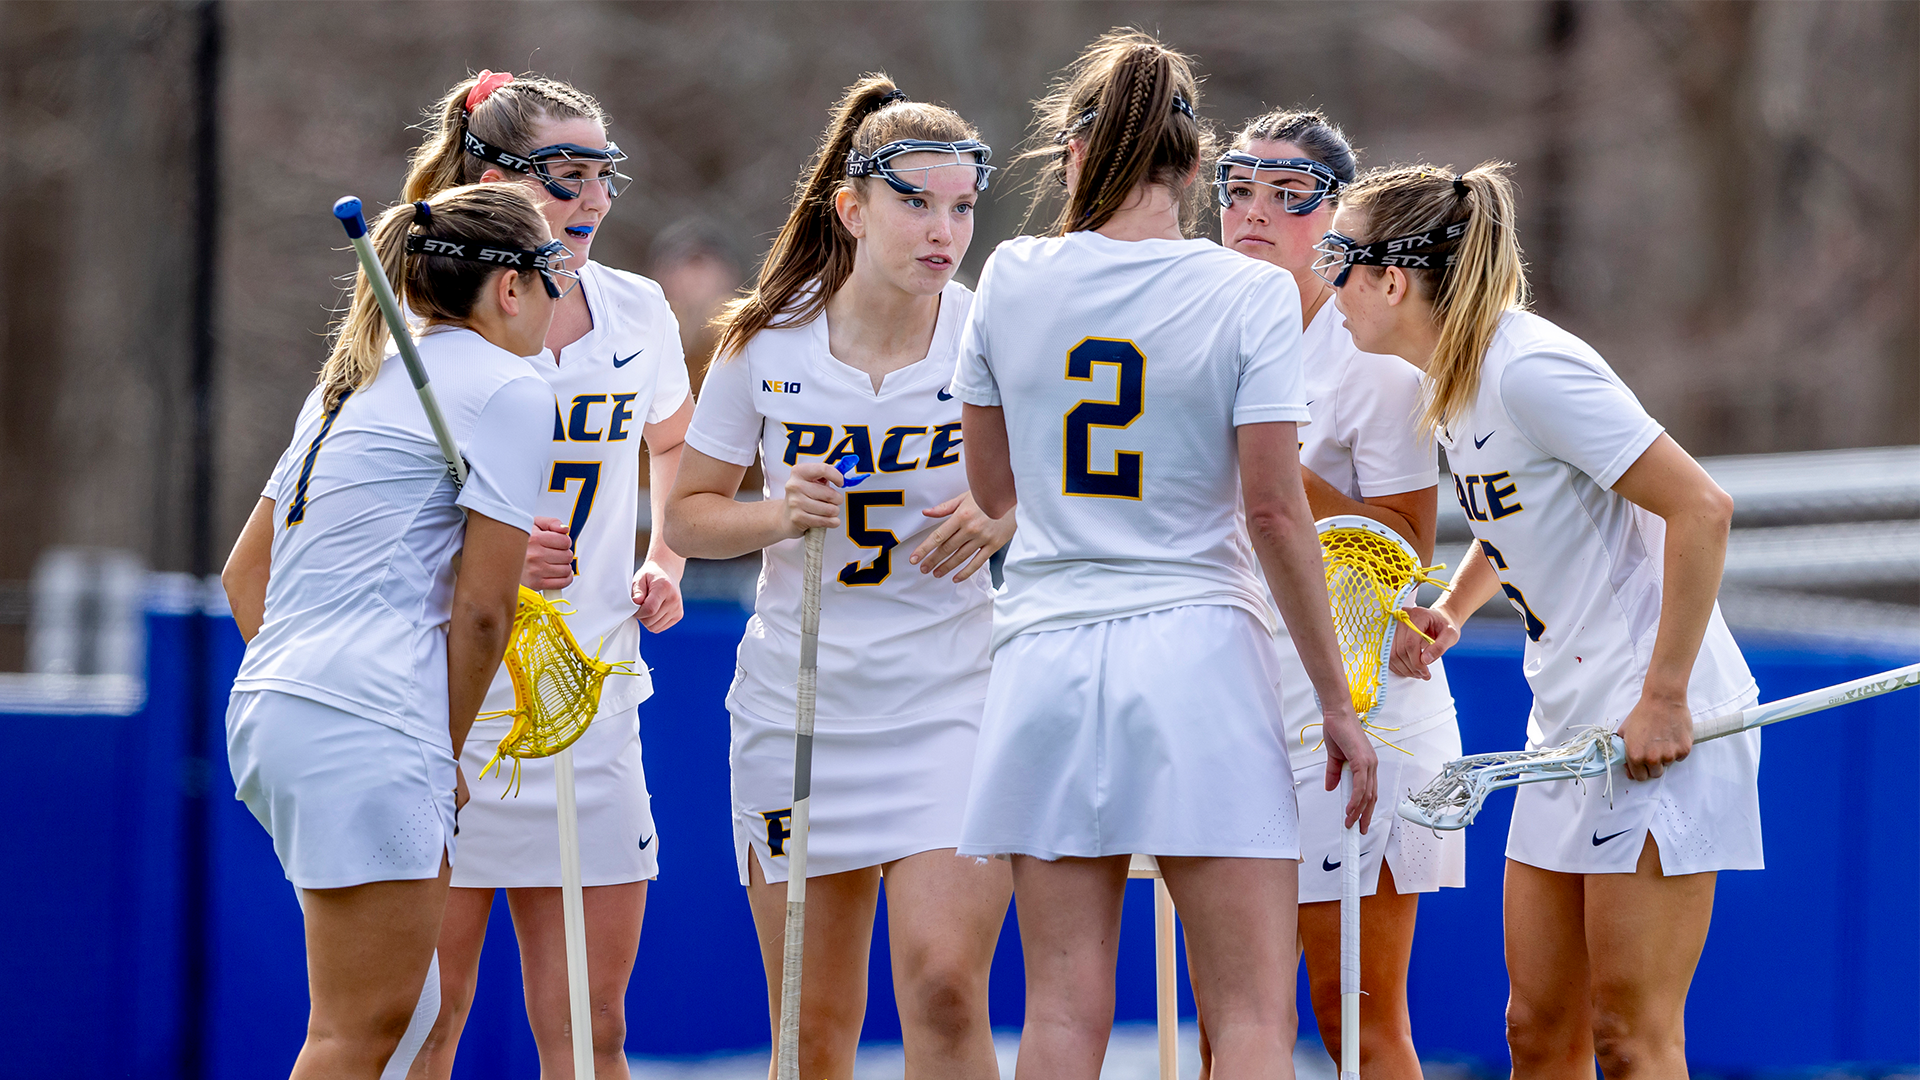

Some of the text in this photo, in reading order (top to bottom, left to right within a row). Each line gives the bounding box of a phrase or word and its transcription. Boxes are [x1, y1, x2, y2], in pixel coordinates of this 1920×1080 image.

[464, 131, 532, 172] TX ST
[848, 162, 864, 175] STX
[423, 239, 465, 257] STX
[478, 248, 522, 265] STX
[1346, 232, 1433, 262] TX STX
[1381, 254, 1430, 267] STX
[762, 380, 802, 394] NE10
[1062, 335, 1147, 501] 2
[781, 421, 963, 474] PACE
[548, 461, 602, 576] 7
[837, 489, 905, 588] 5
